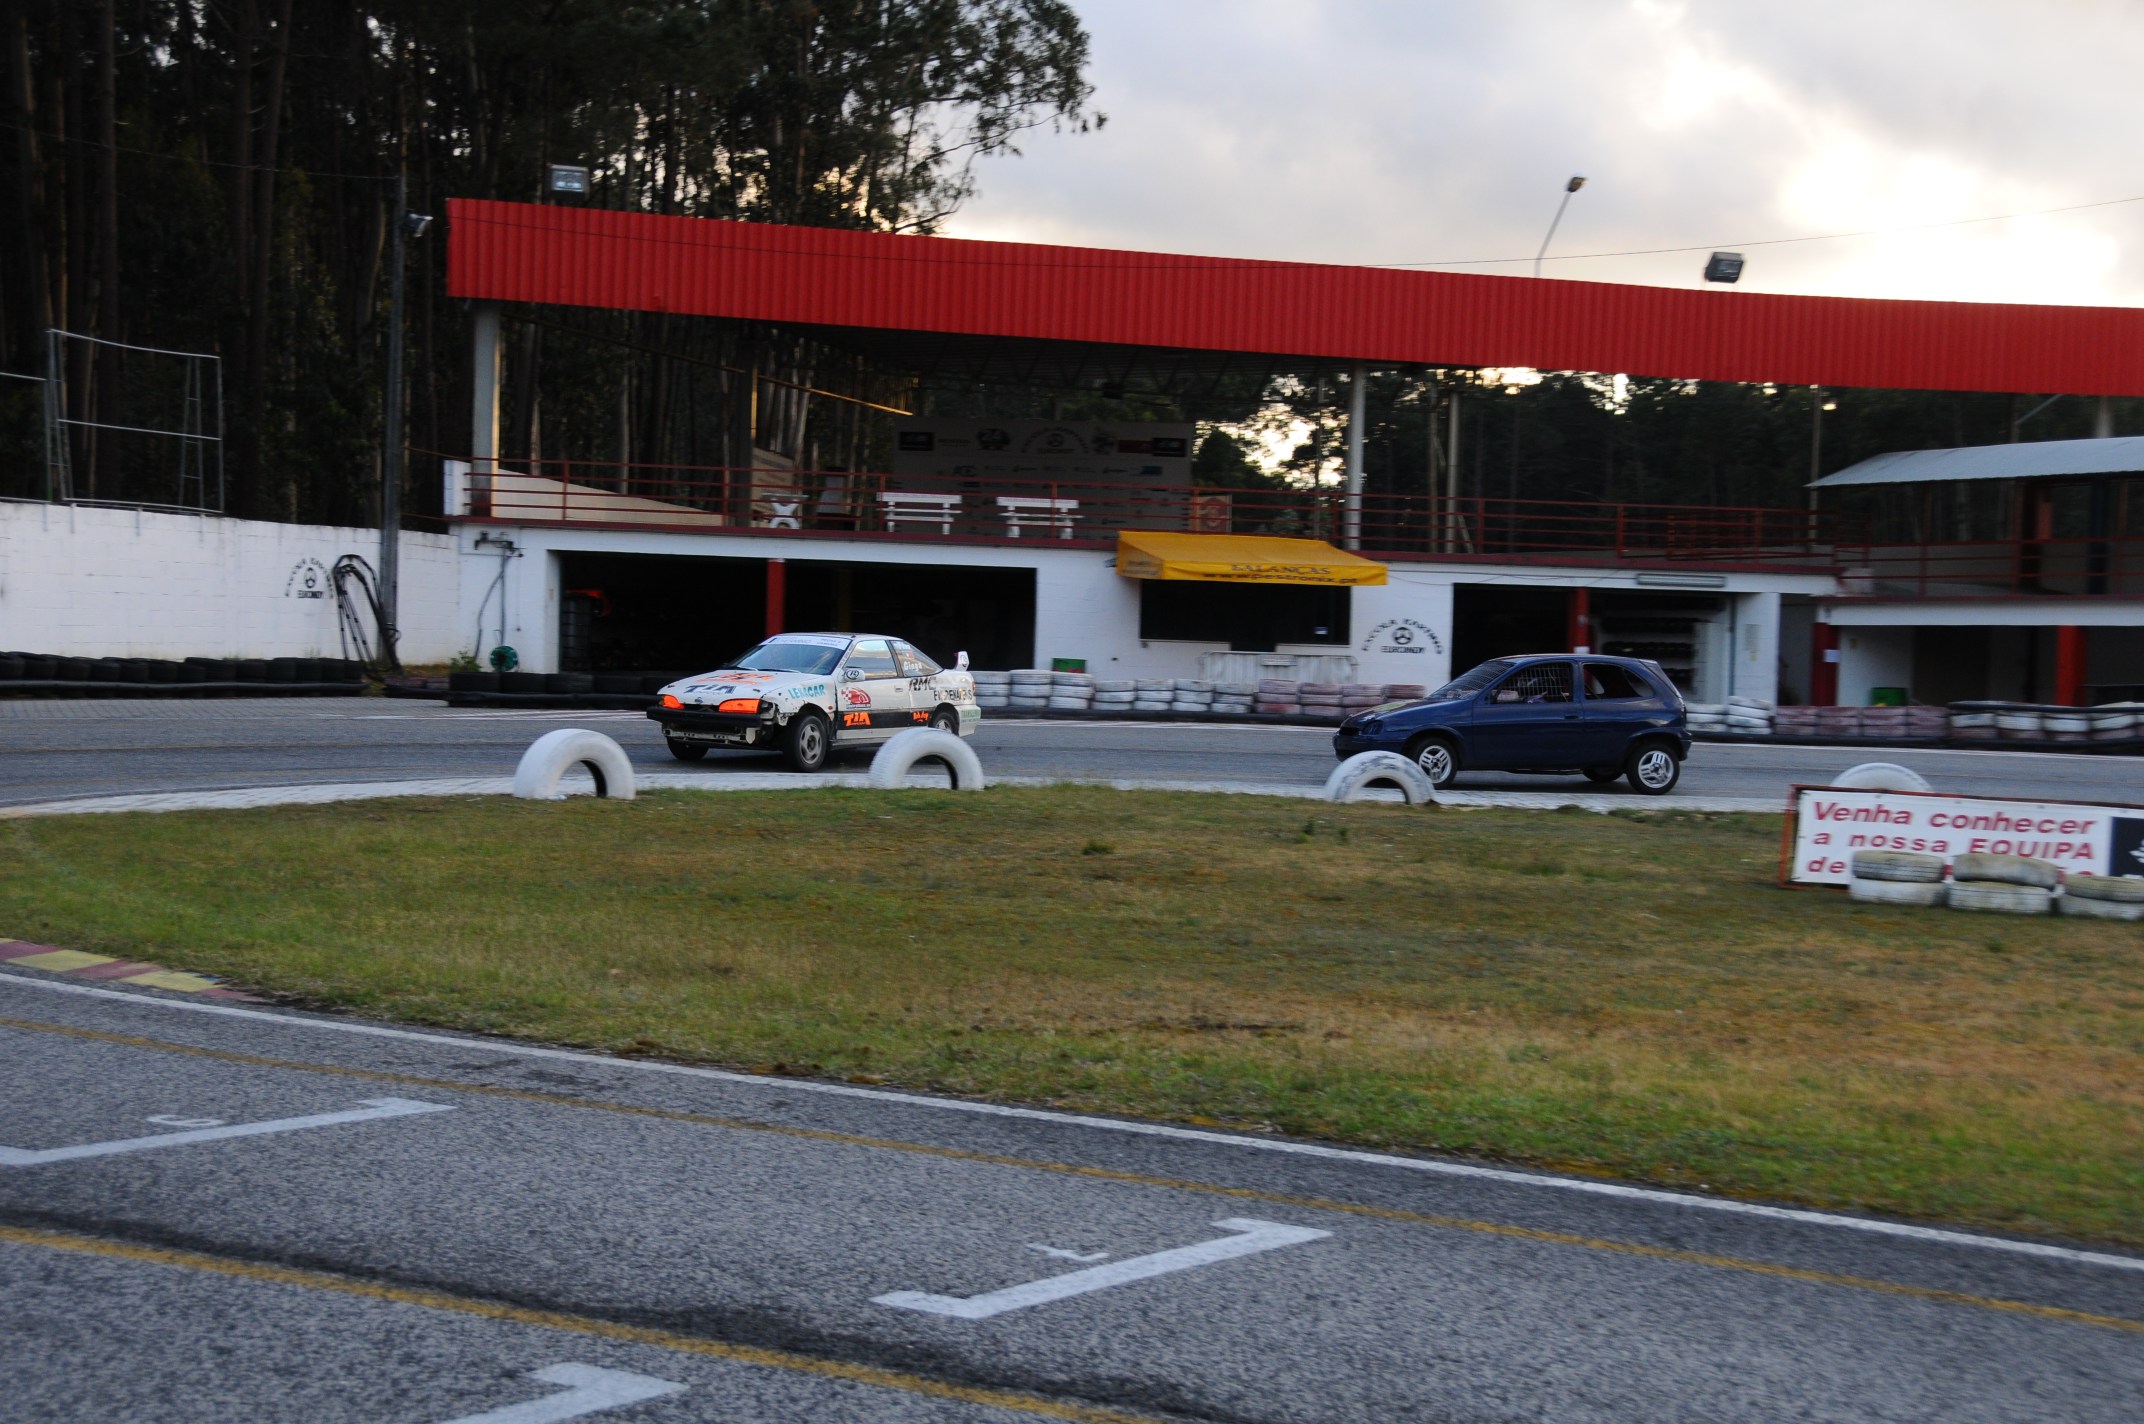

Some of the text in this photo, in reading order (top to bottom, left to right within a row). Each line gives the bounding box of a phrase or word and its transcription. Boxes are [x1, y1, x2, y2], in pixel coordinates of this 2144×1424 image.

[1814, 801, 2096, 835] Venha conhecer
[1813, 832, 2095, 860] a nossa EQUIPA
[1807, 856, 1846, 874] de
